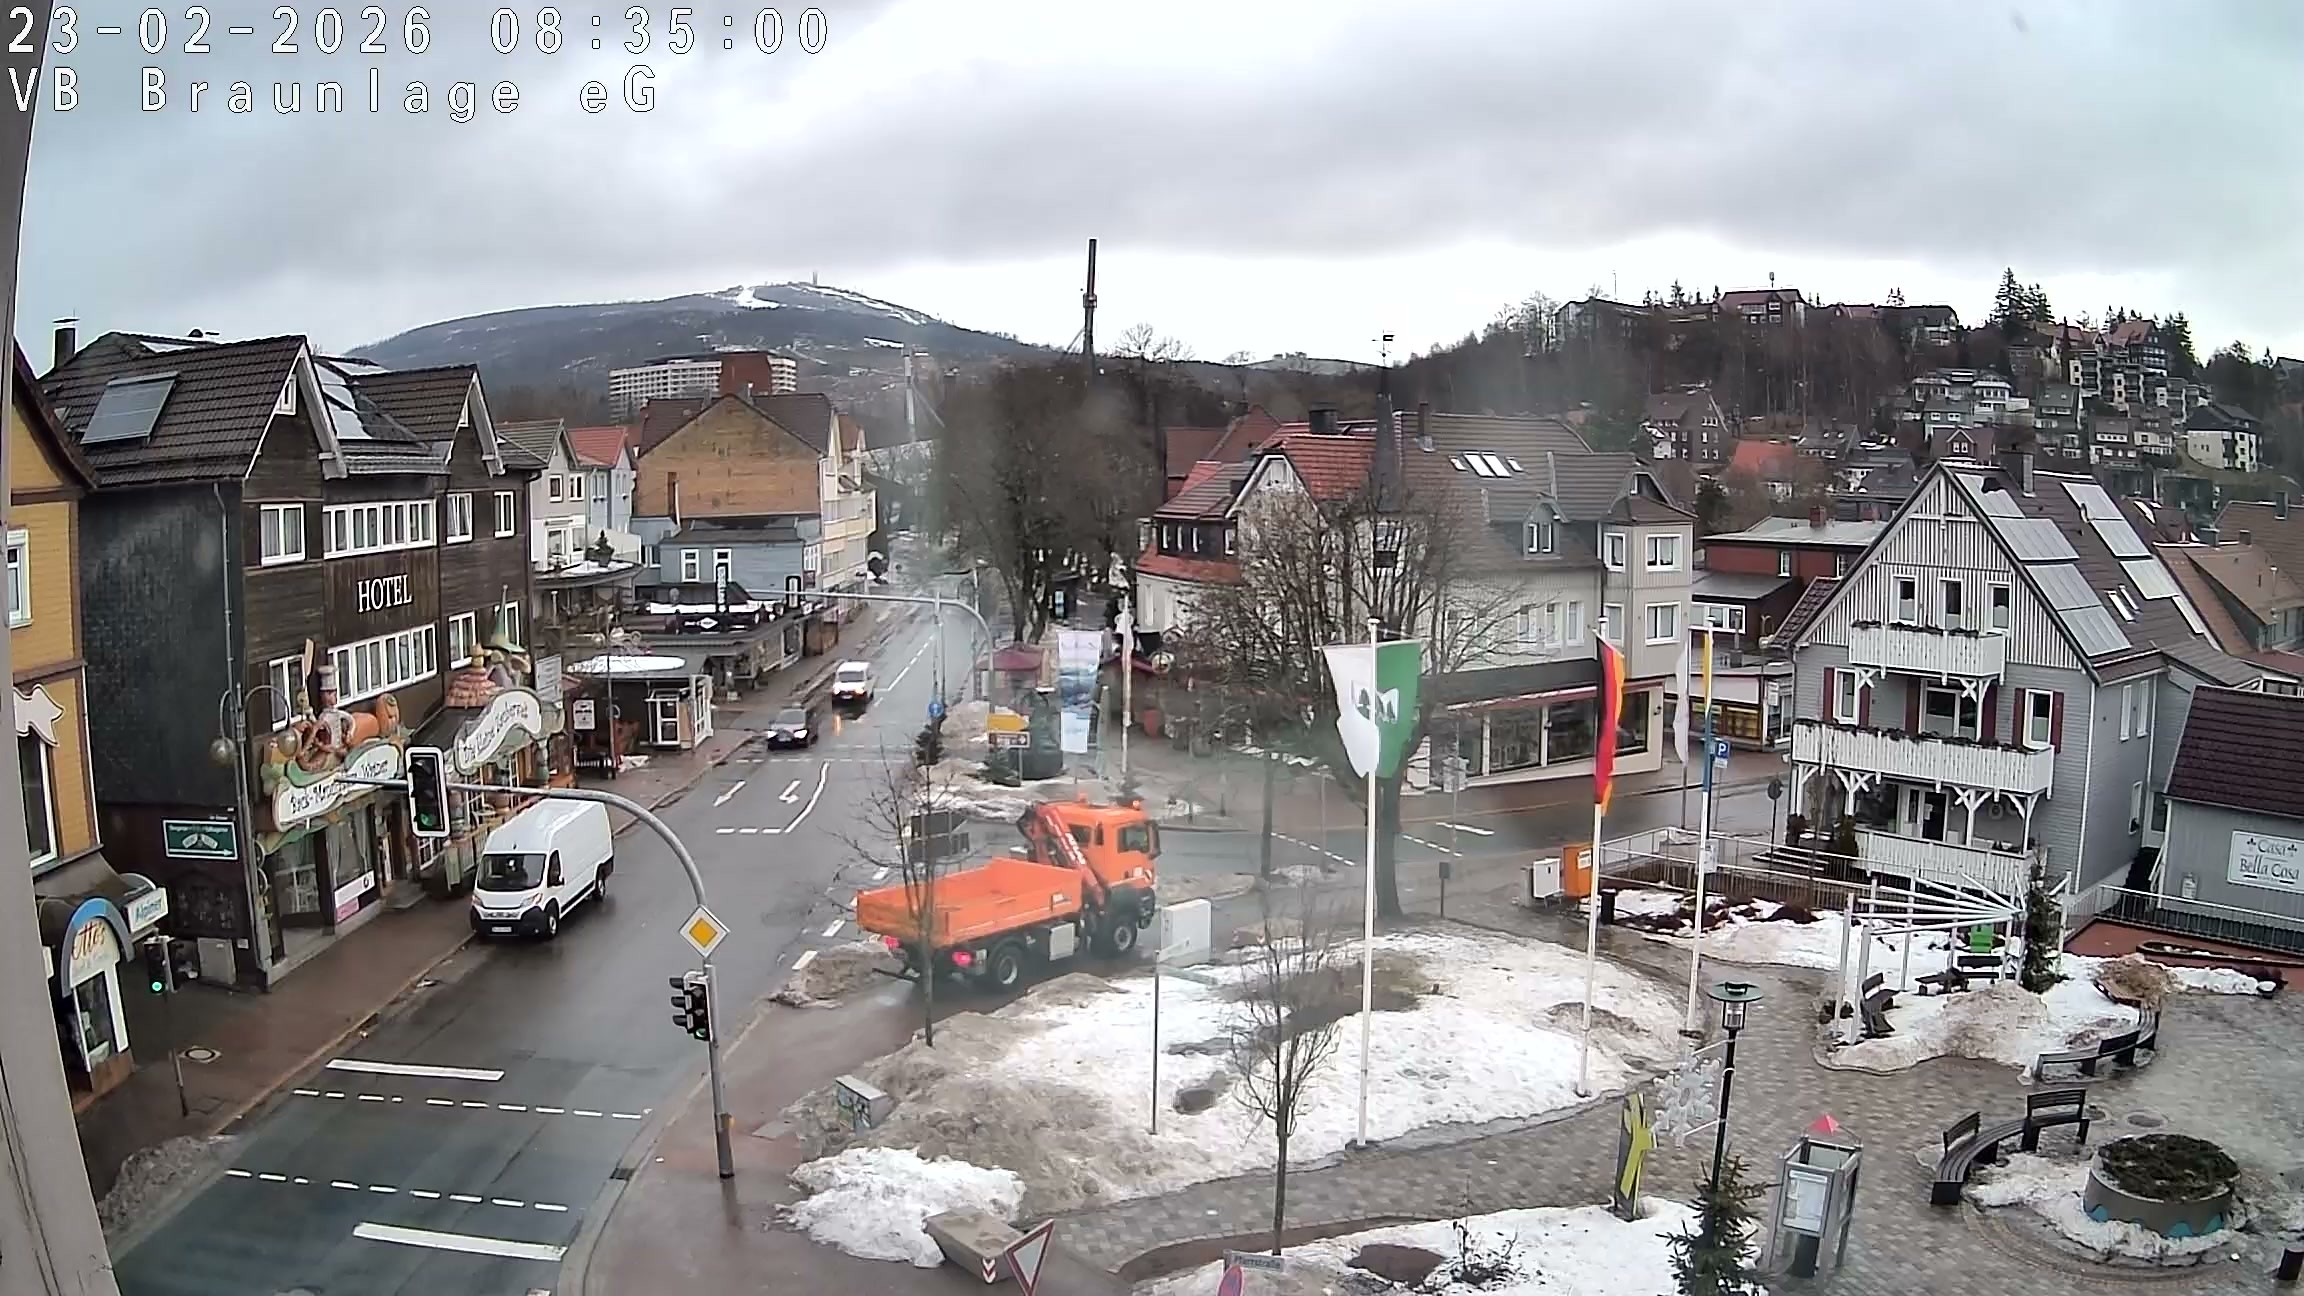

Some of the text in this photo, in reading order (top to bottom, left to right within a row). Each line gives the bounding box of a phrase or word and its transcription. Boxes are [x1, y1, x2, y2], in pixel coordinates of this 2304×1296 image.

[357, 574, 412, 613] HOTEL
[1718, 743, 1727, 756] P
[2239, 855, 2300, 880] Bella Casa
